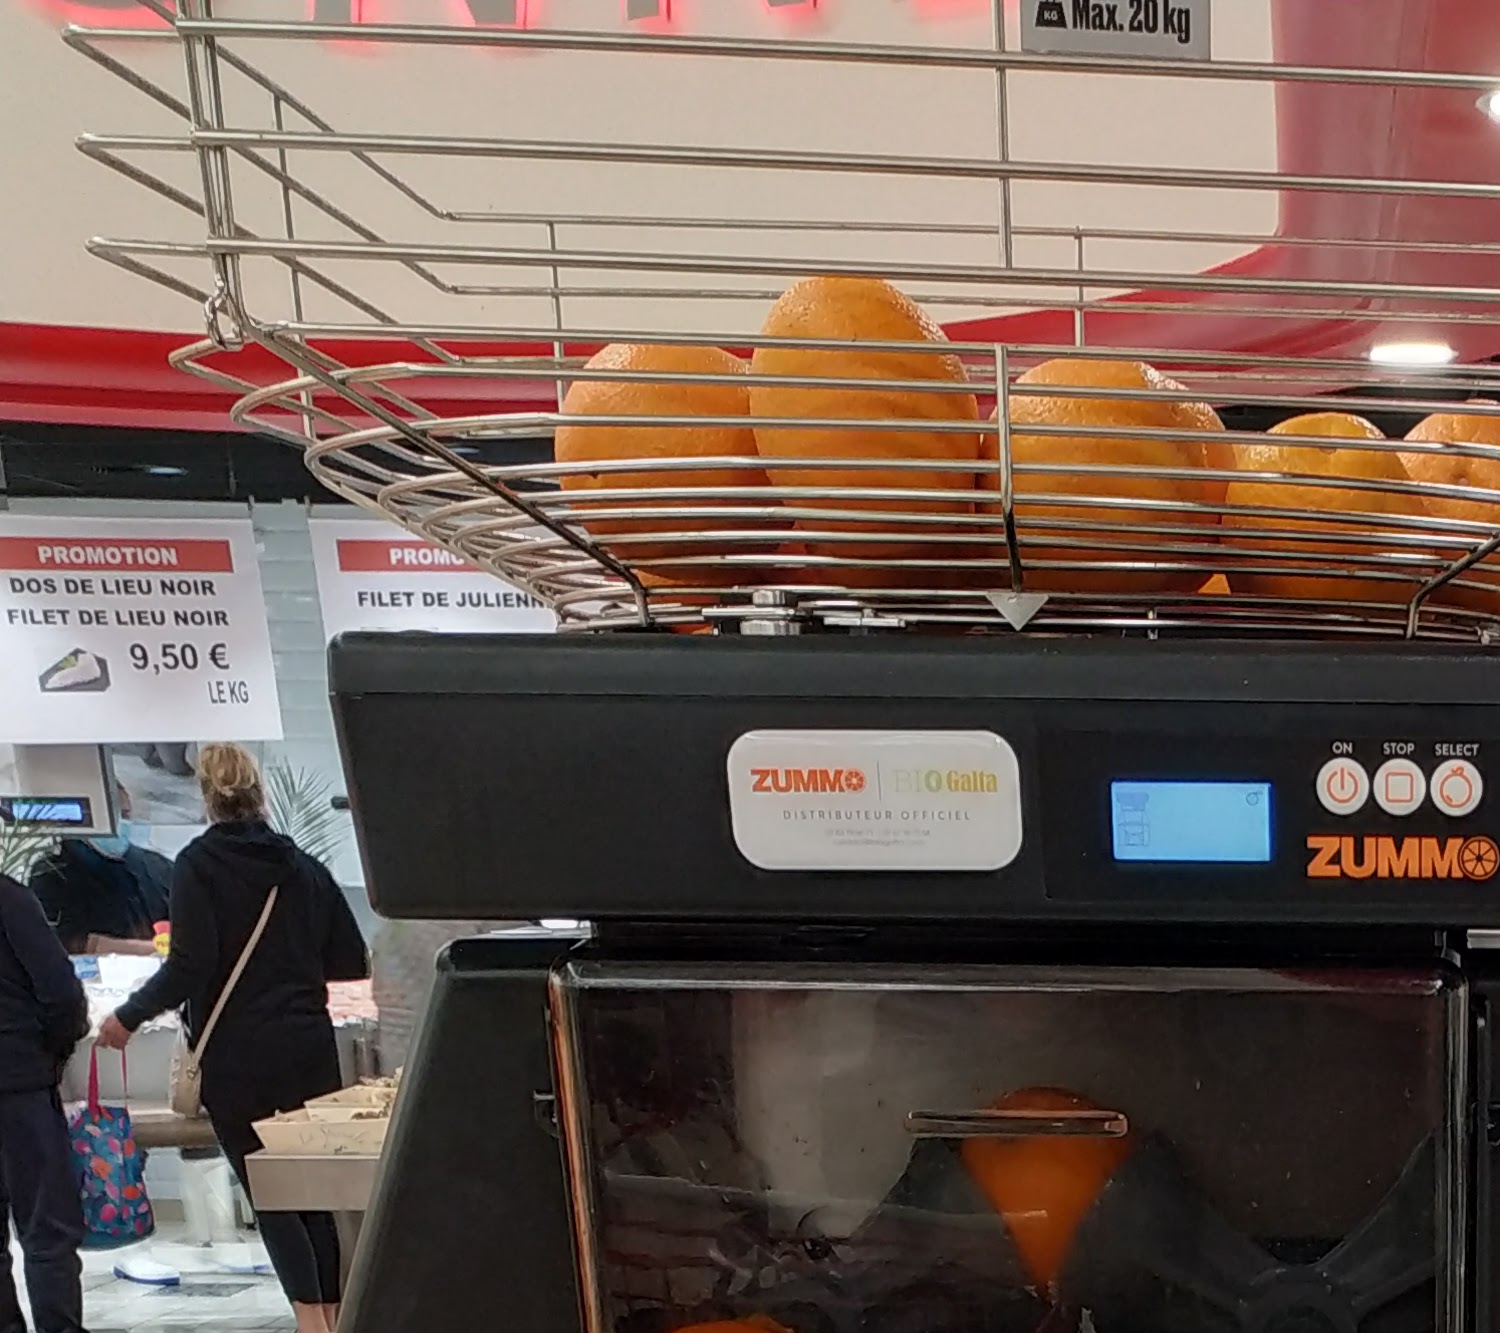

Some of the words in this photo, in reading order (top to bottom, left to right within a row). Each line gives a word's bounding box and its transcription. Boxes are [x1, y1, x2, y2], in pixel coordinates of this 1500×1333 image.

[1072, 0, 1124, 32] Max.
[1129, 0, 1158, 34] 20
[1163, 0, 1191, 44] kg
[37, 545, 178, 566] PROMOTION
[9, 577, 57, 595] DOS
[64, 578, 94, 596] DE
[101, 578, 152, 596] LIEU
[160, 579, 217, 597] NOIR
[357, 591, 416, 608] FILET
[422, 591, 450, 608] DE
[7, 608, 71, 626] FILET
[78, 609, 109, 626] DE
[115, 610, 166, 627] LIEU
[173, 610, 230, 627] NOIR
[129, 643, 200, 676] 9,50
[209, 642, 230, 670] €
[207, 681, 226, 704] LE
[229, 681, 250, 704] KG
[1332, 742, 1353, 755] ON
[1382, 742, 1415, 756] STOP
[1434, 743, 1479, 757] SELECT
[751, 768, 866, 793] ZUMMO
[782, 810, 893, 821] DISTRIBUTEUR
[900, 810, 972, 821] OFFICIEL
[1306, 835, 1500, 880] ZUMMO
